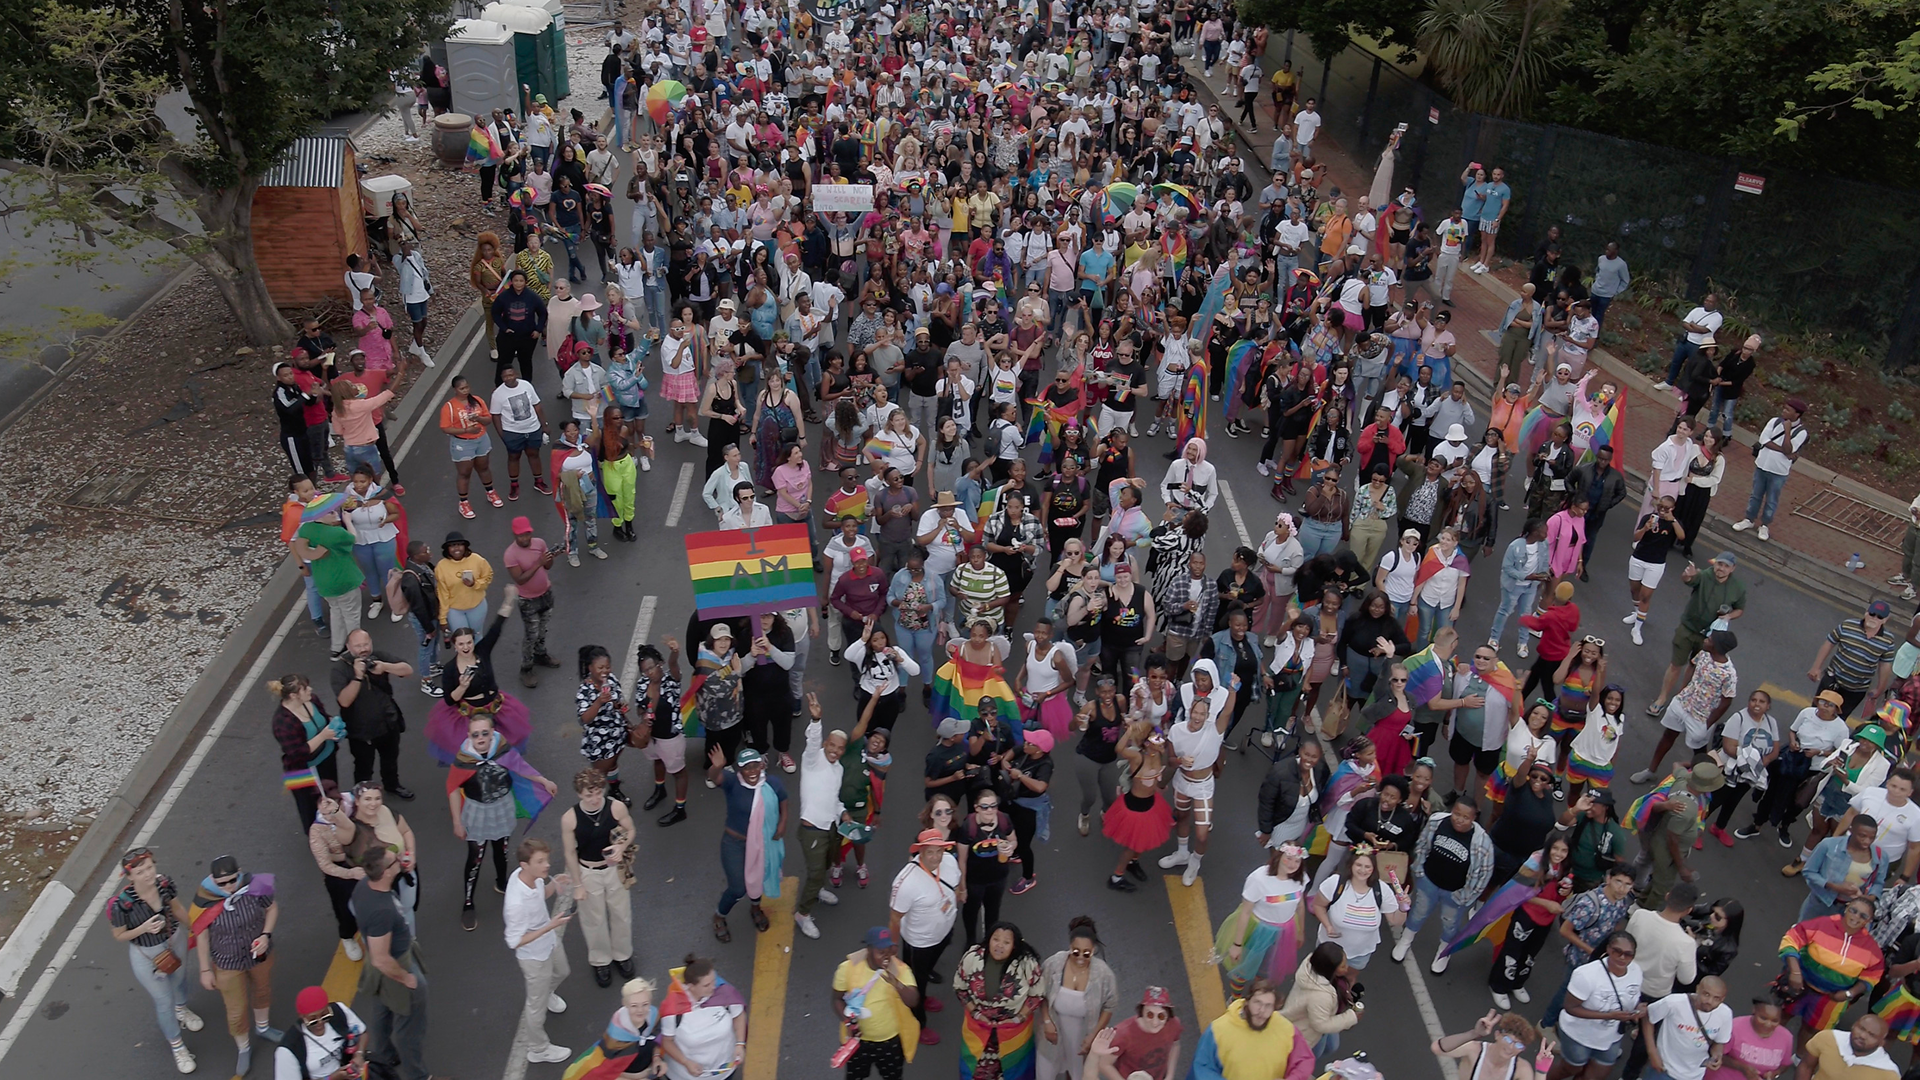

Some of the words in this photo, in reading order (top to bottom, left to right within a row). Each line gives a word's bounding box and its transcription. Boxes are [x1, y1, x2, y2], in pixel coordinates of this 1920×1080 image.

[1738, 175, 1764, 186] CLEARVU
[826, 185, 846, 194] WILL
[852, 186, 869, 195] NOT
[834, 196, 868, 205] SCARED
[1093, 350, 1113, 359] NASA
[1002, 492, 1031, 506] LE
[741, 527, 766, 555] I
[730, 555, 791, 590] AM
